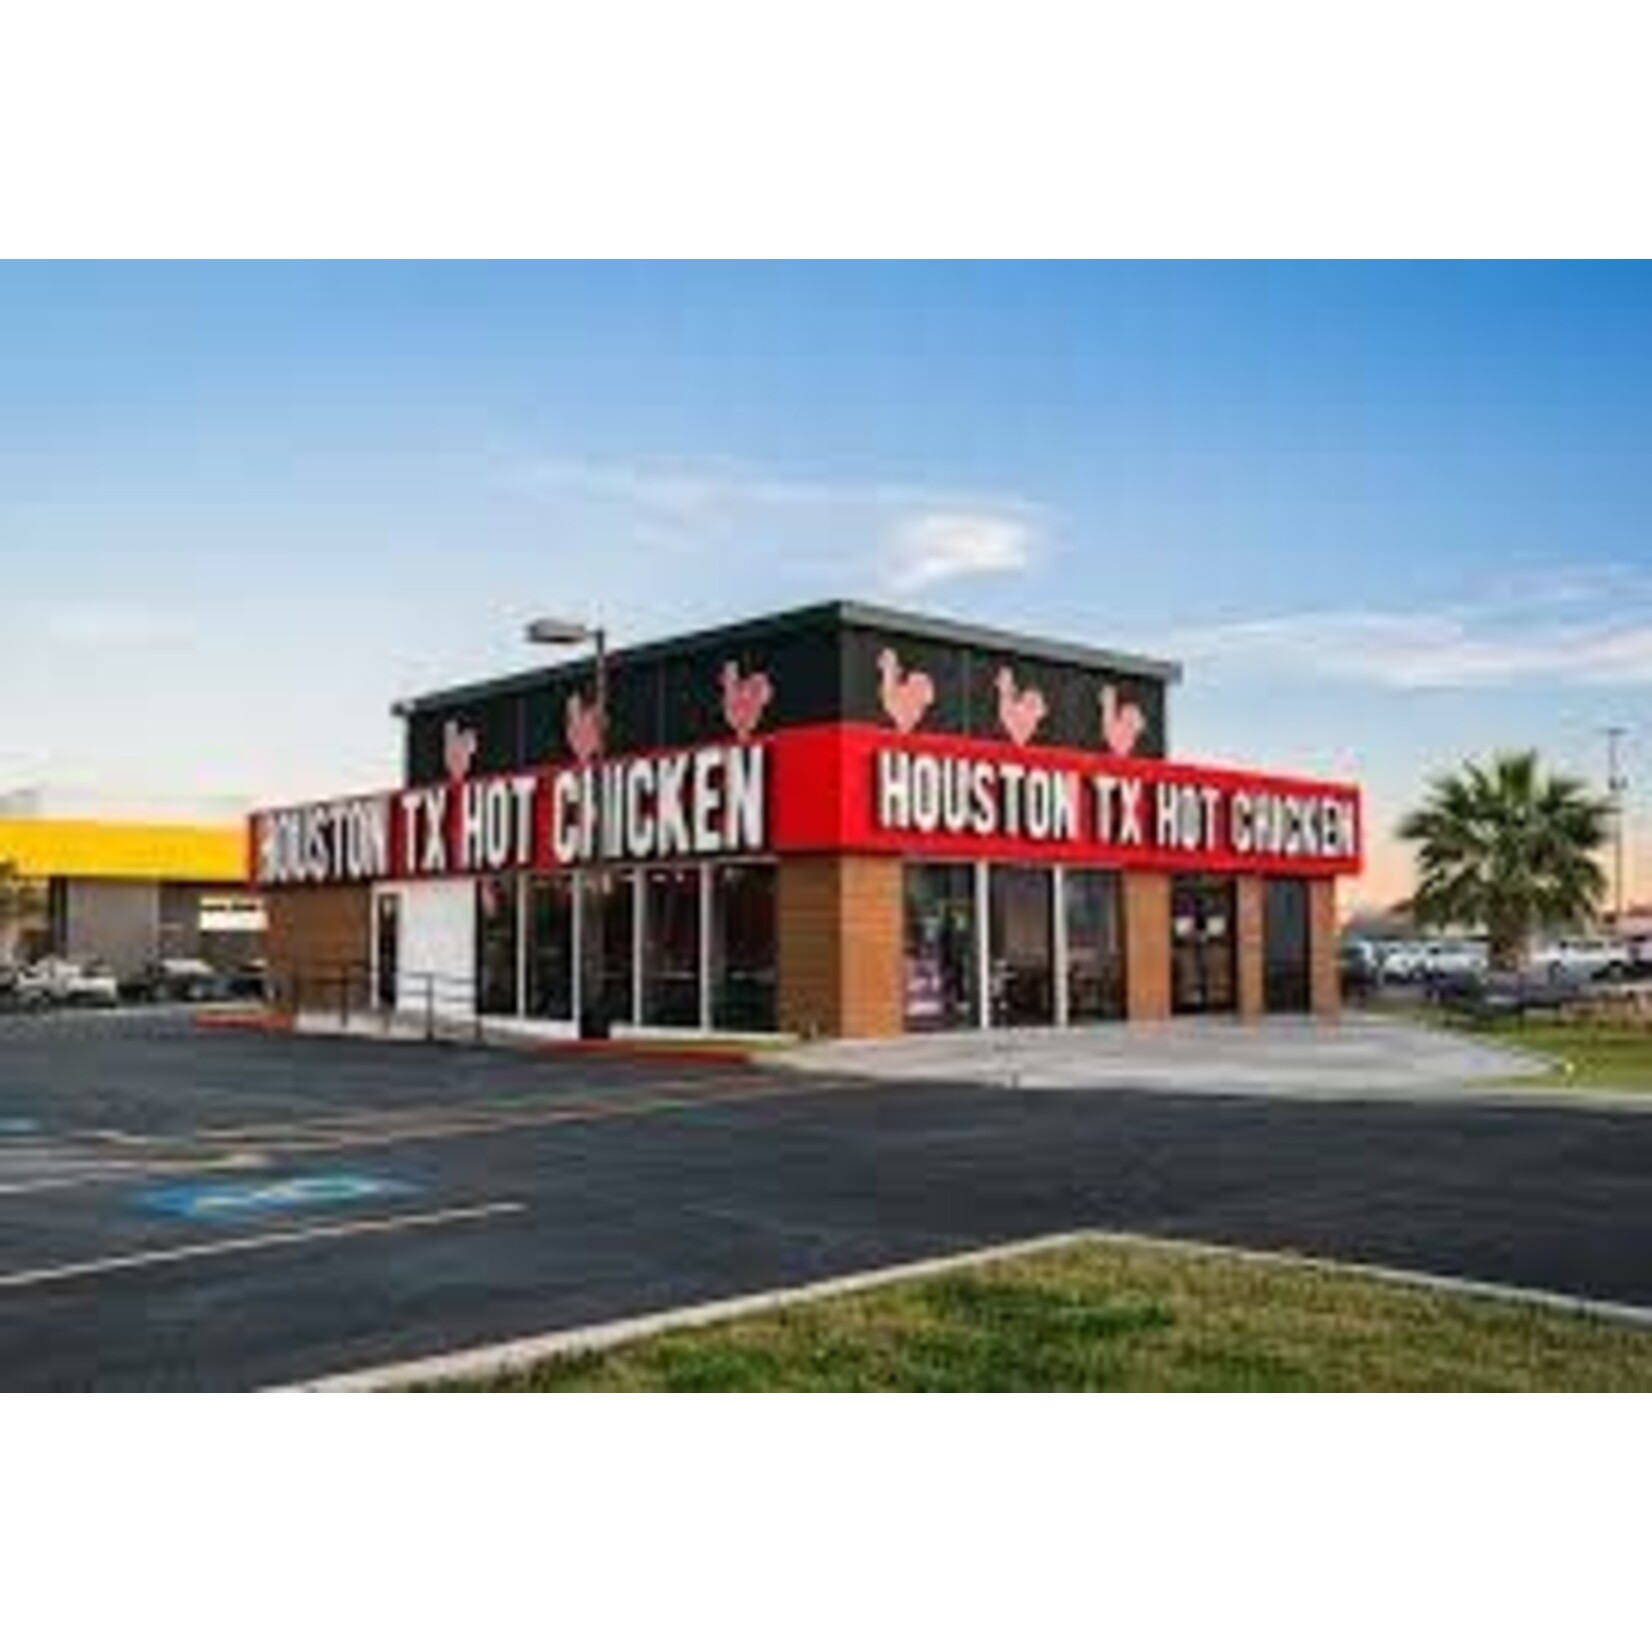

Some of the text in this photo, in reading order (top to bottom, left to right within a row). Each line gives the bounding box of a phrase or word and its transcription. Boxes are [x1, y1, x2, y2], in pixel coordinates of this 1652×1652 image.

[260, 746, 764, 880] HOUSTON TX HOT CHICKEN
[878, 751, 1354, 856] HOUSTON TX HOT CHICKEN
